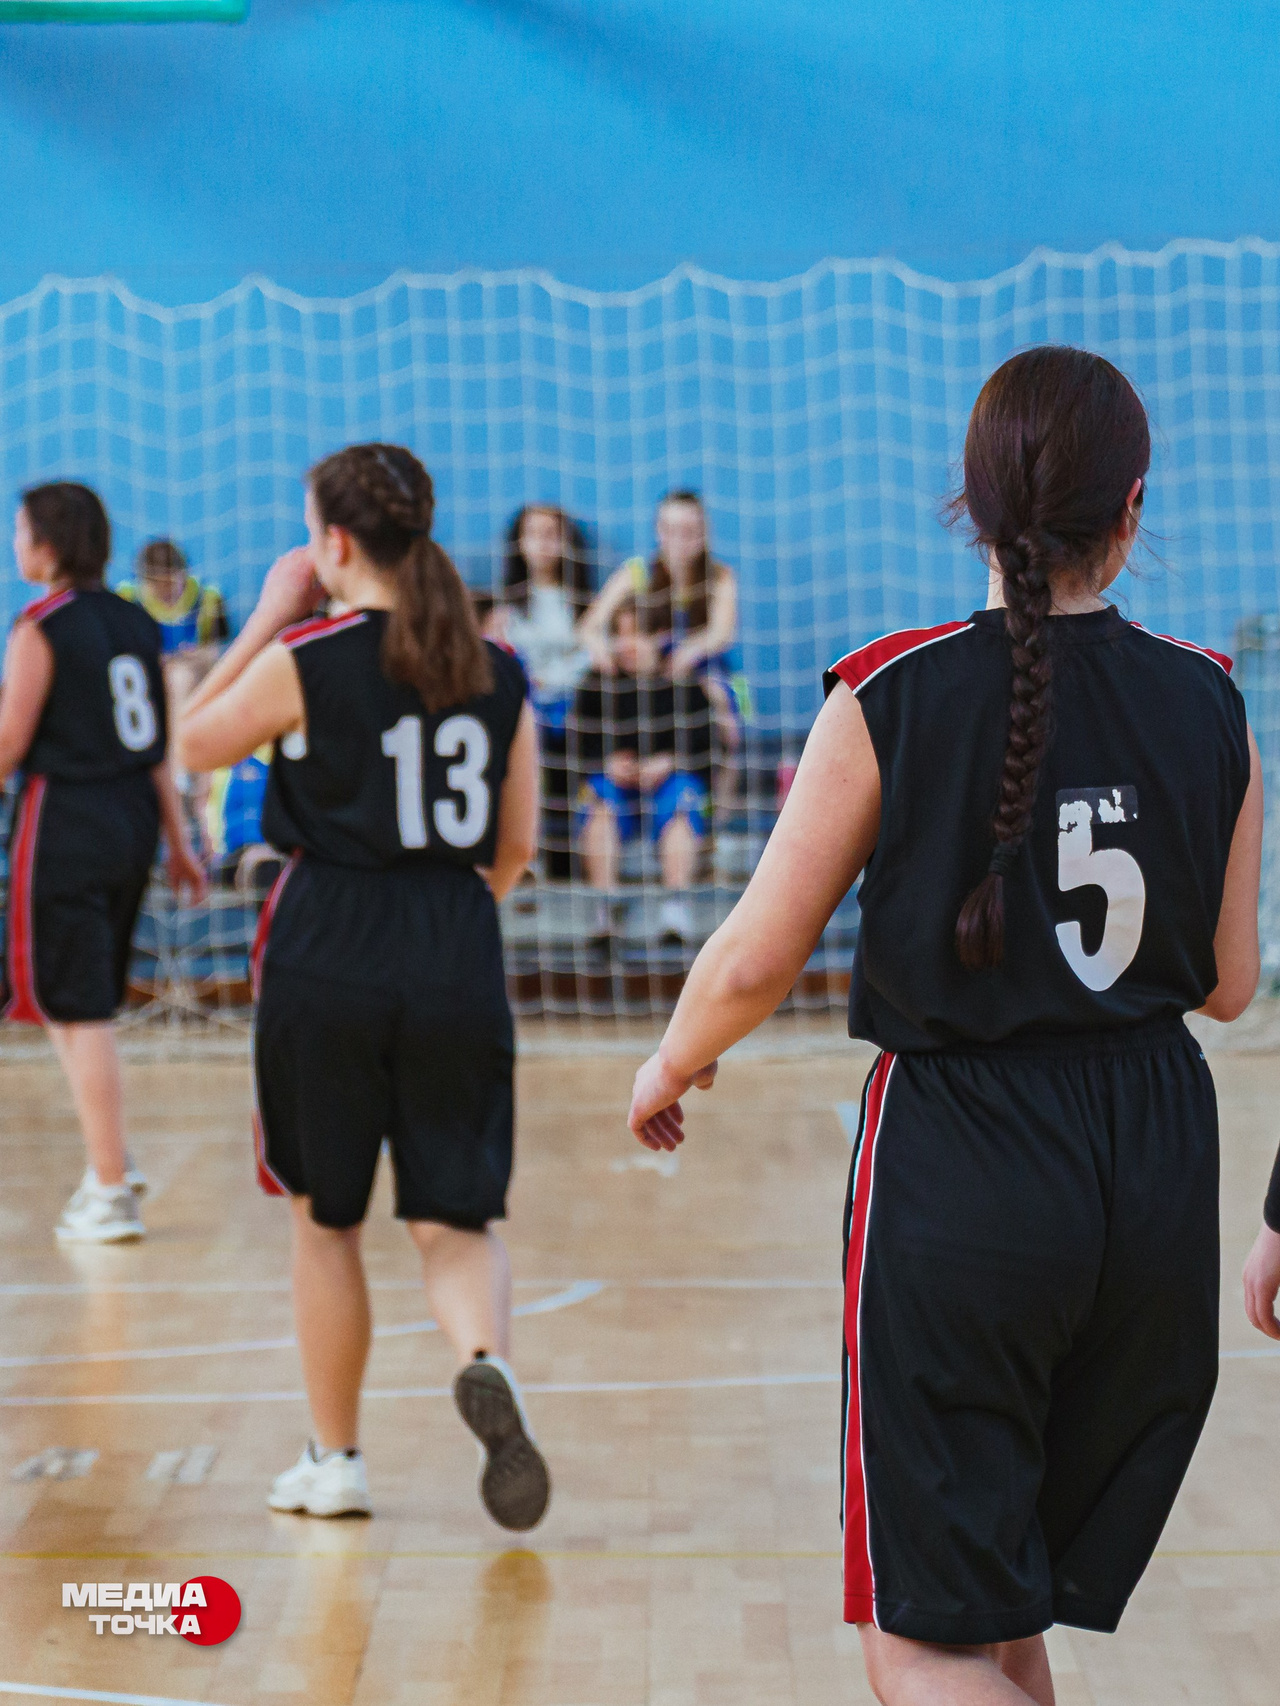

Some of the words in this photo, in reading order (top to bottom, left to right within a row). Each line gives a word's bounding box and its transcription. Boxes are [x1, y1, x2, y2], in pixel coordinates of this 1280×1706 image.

[109, 654, 157, 752] 8
[381, 714, 491, 850] 13
[1055, 787, 1146, 991] 5
